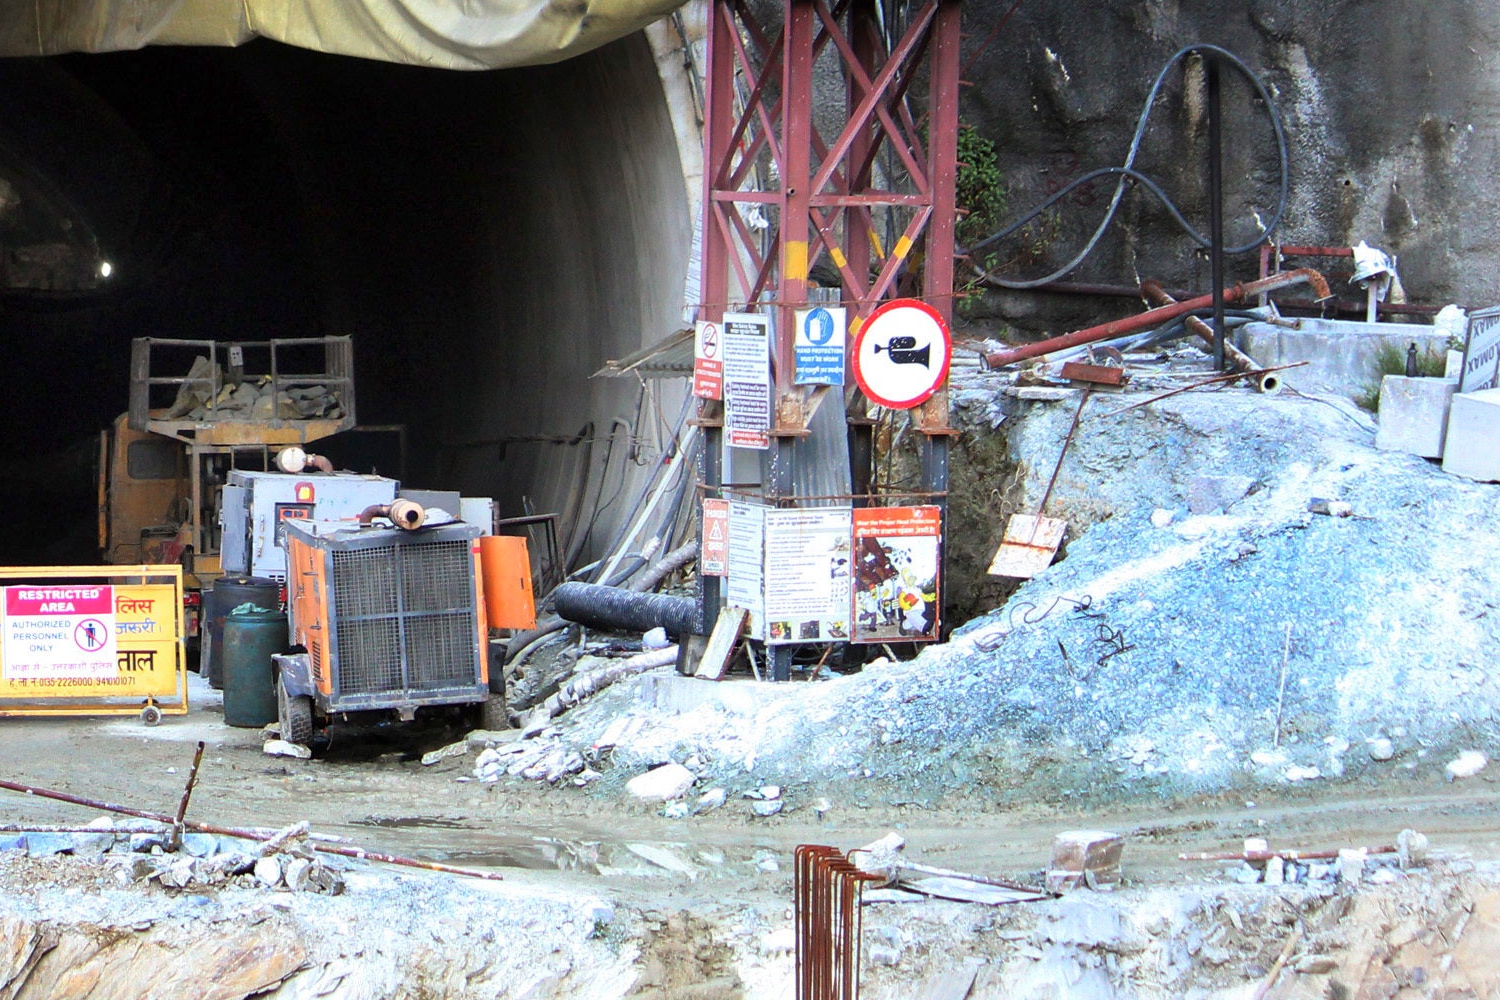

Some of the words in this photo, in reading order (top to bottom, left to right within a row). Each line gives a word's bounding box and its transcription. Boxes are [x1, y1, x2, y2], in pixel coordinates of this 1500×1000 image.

[18, 588, 99, 600] RESTRICTED
[40, 601, 75, 613] AREA
[12, 619, 71, 629] AUTHORIZED
[13, 631, 69, 641] PERSONNEL
[29, 643, 54, 652] ONLY
[95, 676, 135, 687] 9410101071
